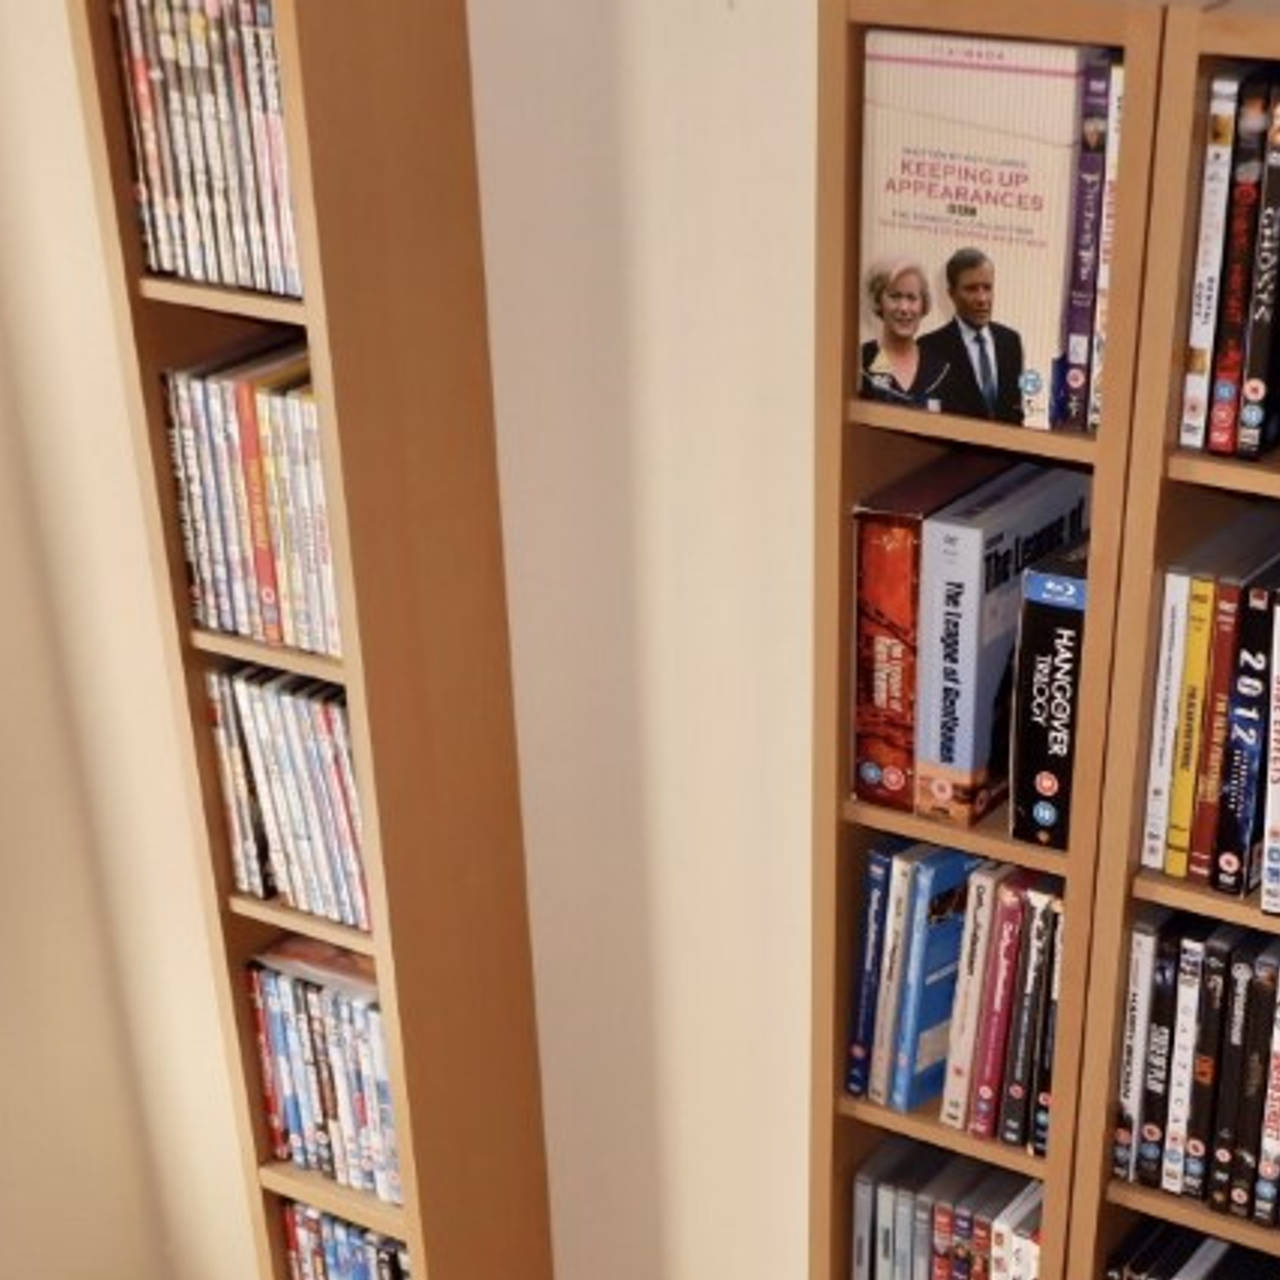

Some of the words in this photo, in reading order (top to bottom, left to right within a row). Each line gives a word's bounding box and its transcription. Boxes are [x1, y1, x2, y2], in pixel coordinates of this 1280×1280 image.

[885, 178, 1044, 212] APPEARANCES
[900, 160, 994, 184] KEEPING
[998, 172, 1030, 188] UP
[945, 581, 964, 609] The
[940, 611, 962, 664] League
[942, 666, 959, 685] of
[1029, 654, 1051, 727] TRILOGY
[1046, 627, 1075, 757] HANGOVER
[1229, 648, 1267, 747] 2012
[937, 686, 960, 764] Gentlemen
